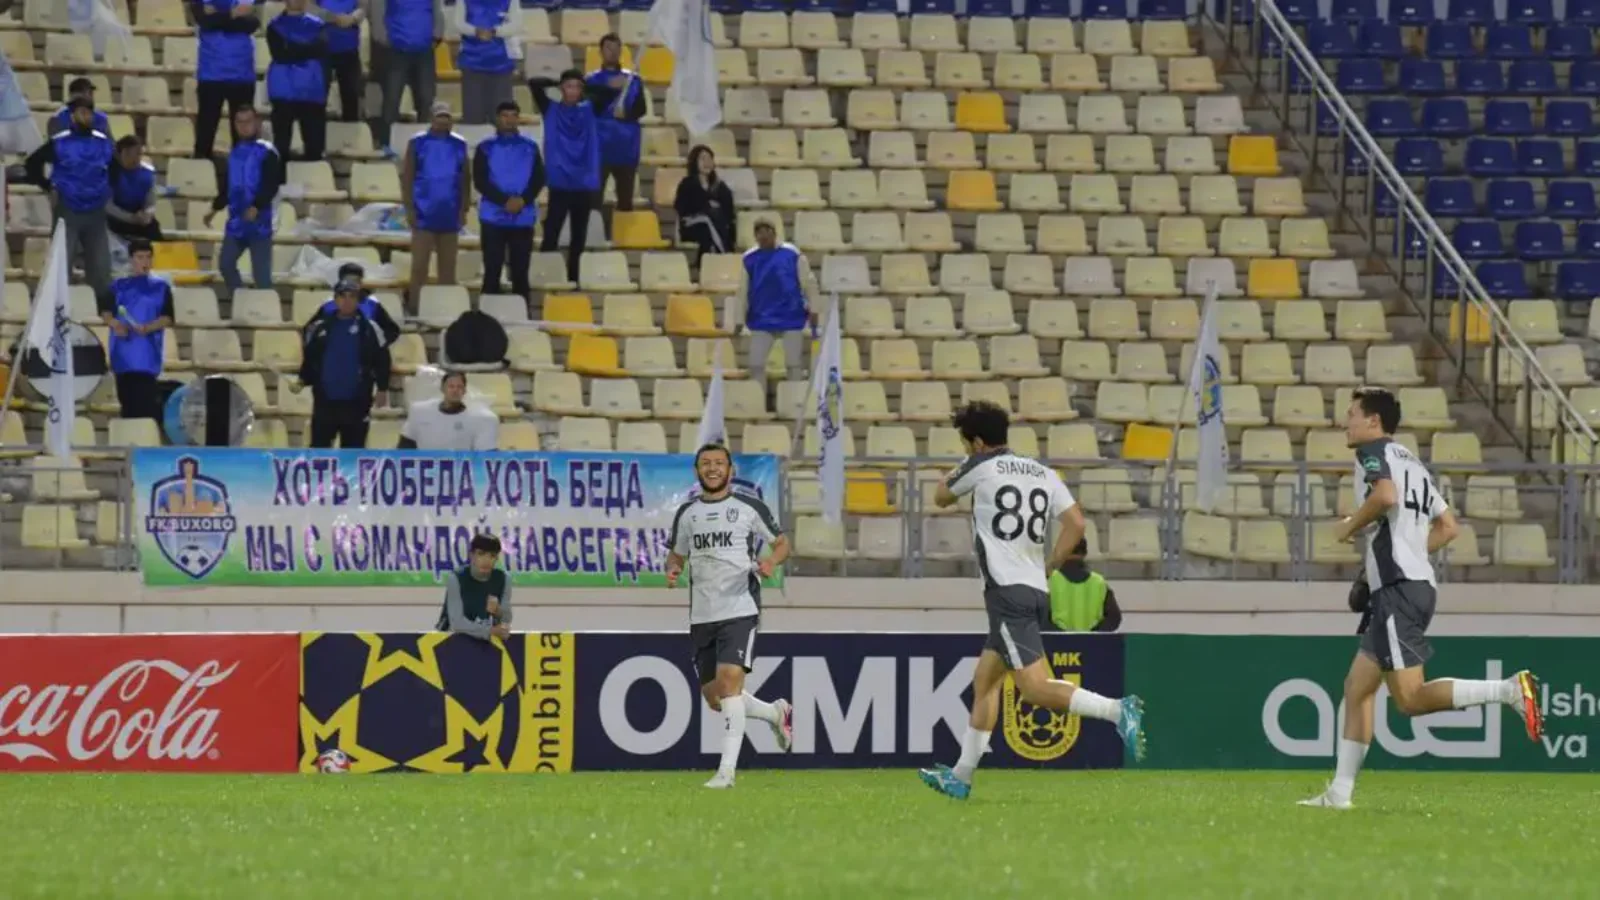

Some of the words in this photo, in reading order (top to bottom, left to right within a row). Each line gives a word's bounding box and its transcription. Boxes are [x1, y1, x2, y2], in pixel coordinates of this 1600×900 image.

[996, 460, 1046, 479] SIAVASH
[272, 458, 349, 506] ХОТЬ
[358, 458, 476, 517] ПОБЕДА
[484, 459, 560, 508] ХОТЬ
[568, 460, 644, 518] БЕДА
[149, 517, 168, 530] FK
[991, 484, 1049, 544] 88
[245, 525, 295, 572] МЫ
[304, 525, 323, 572] С
[693, 530, 734, 550] OKMK
[599, 655, 993, 755] OKMK
[1540, 733, 1588, 759] va
